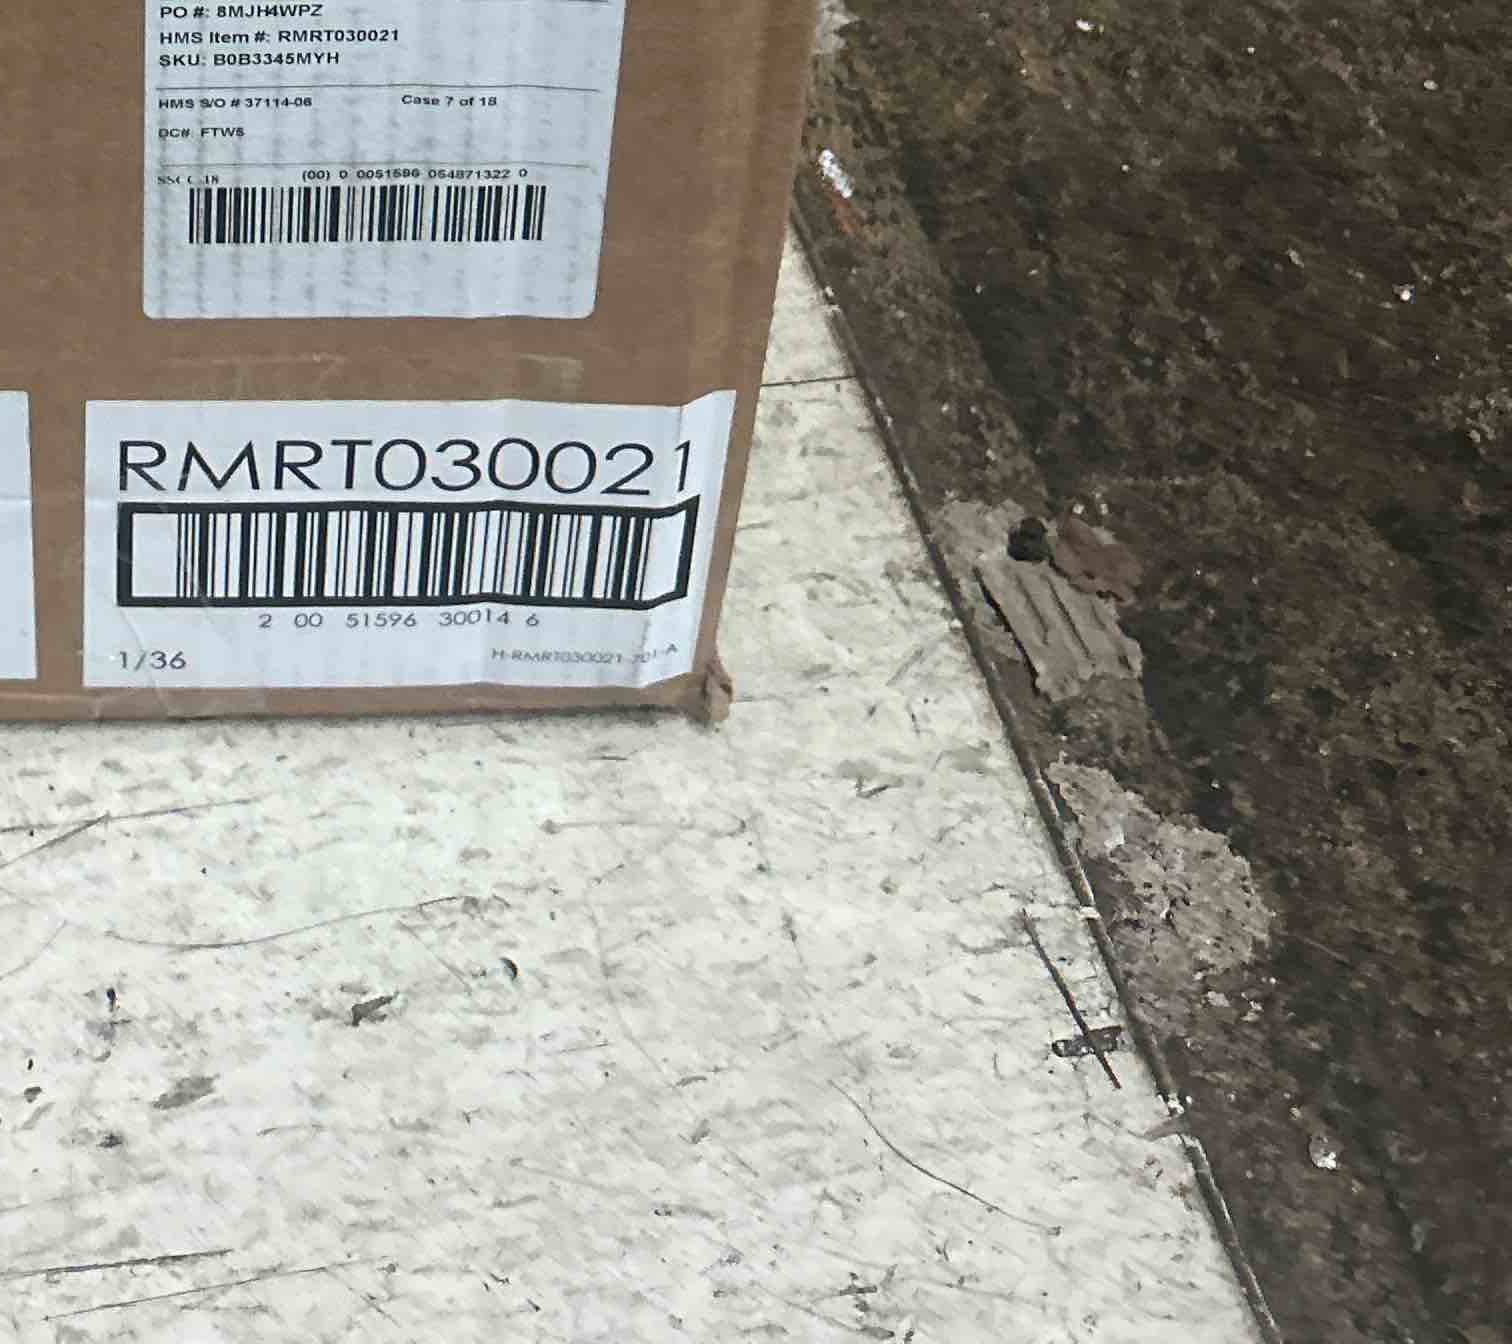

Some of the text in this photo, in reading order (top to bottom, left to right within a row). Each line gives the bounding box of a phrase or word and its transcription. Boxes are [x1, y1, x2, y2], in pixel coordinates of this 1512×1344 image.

[160, 6, 188, 18] PO
[217, 4, 323, 18] 8MJH4WPZ
[160, 31, 202, 44] HMS
[209, 31, 249, 44] Item
[278, 29, 399, 42] RMRT030021
[159, 54, 207, 67] SKU:
[159, 98, 194, 109] HMS
[199, 98, 226, 108] S/O
[401, 94, 440, 105] Case
[459, 96, 474, 106] of
[479, 96, 497, 106] 18
[302, 169, 331, 182] (00)
[118, 439, 692, 496] RMRT030021
[258, 609, 540, 628] 2 00 51596 30014 6
[118, 651, 187, 671] 1/36
